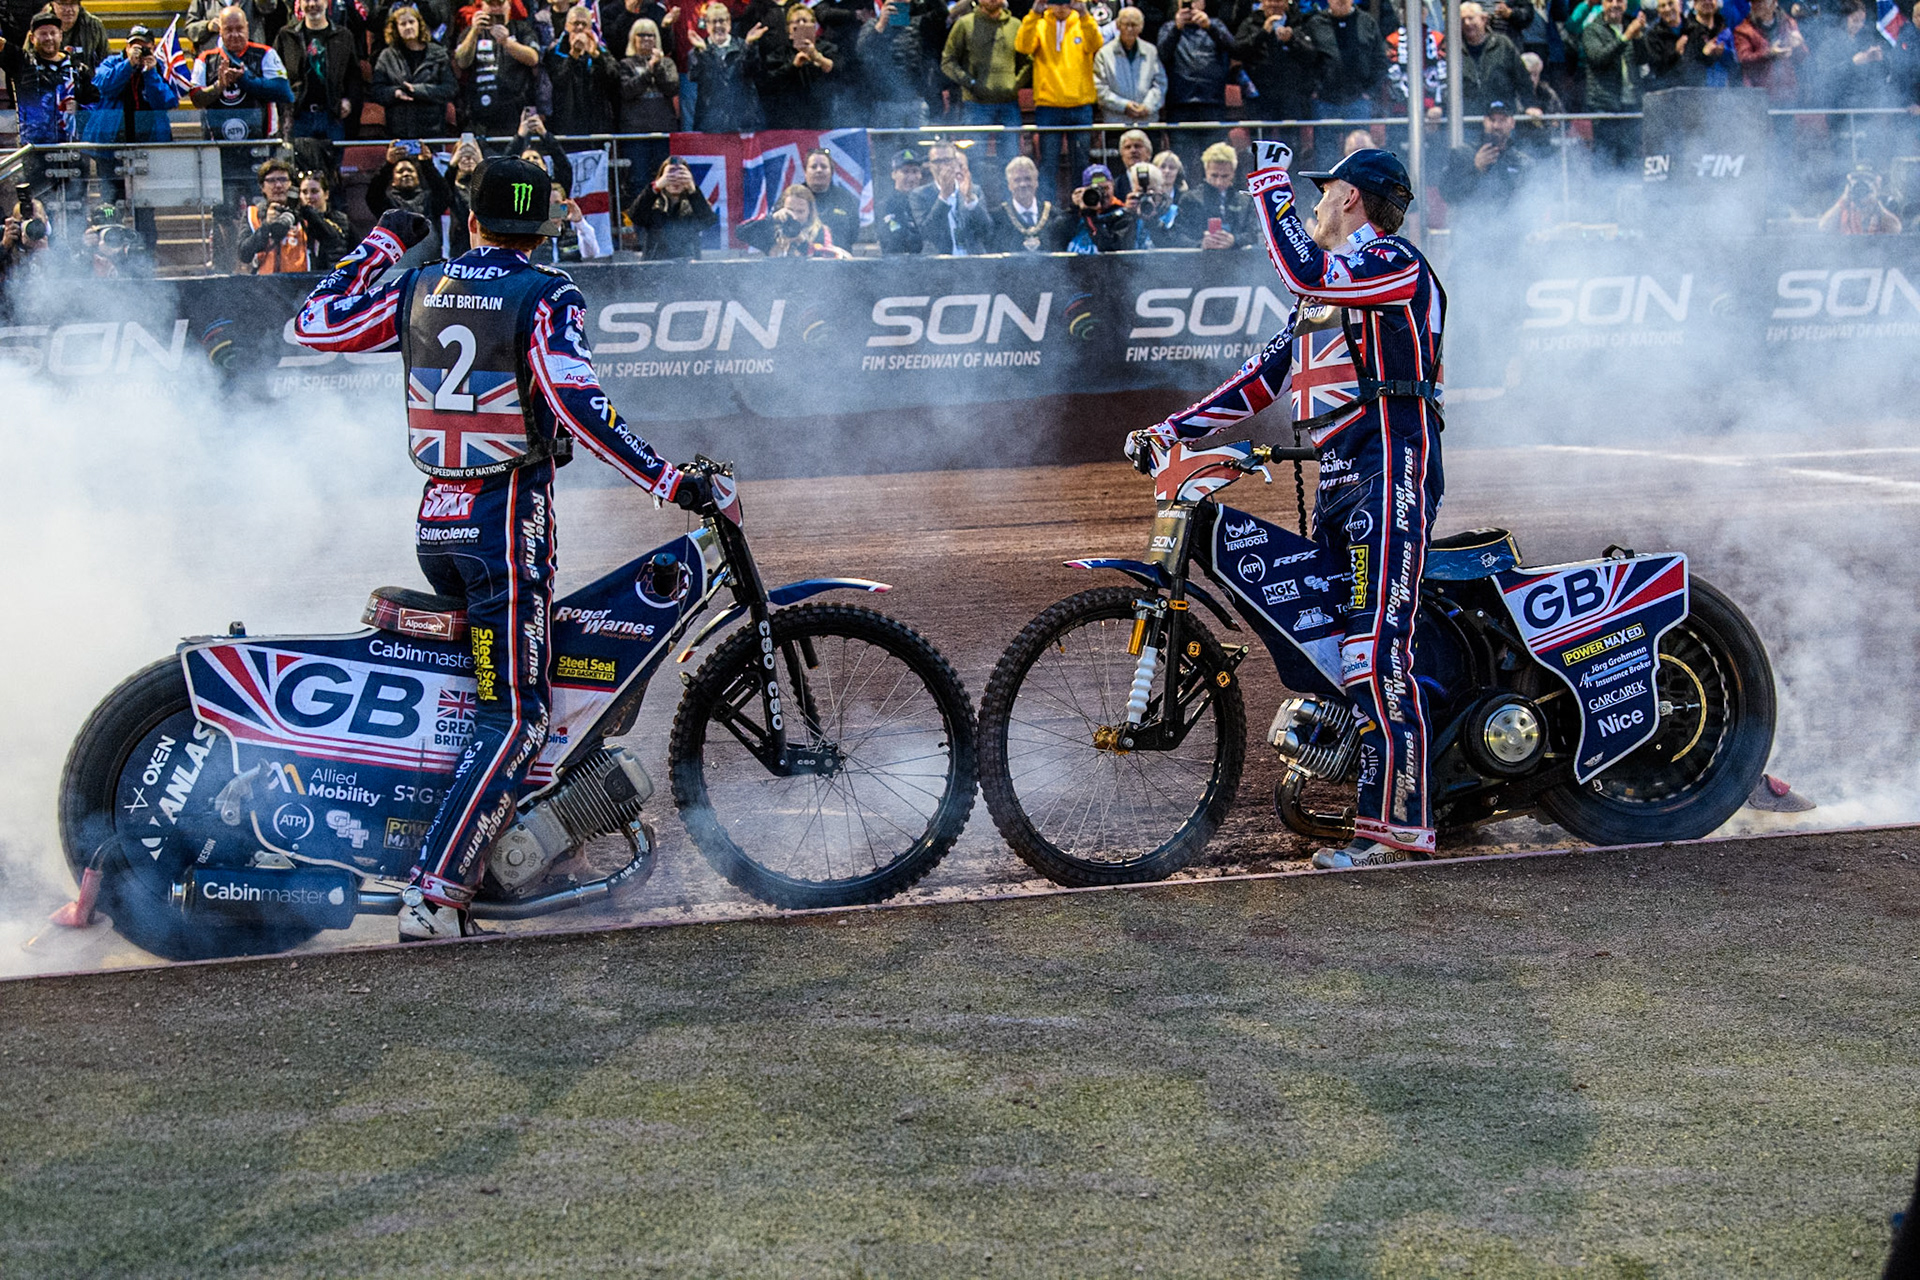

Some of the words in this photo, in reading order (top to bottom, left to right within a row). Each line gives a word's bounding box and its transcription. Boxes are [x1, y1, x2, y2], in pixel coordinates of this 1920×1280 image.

[1643, 155, 1670, 175] SON
[1695, 154, 1745, 177] FIM
[1279, 218, 1311, 263] Mobility
[423, 294, 454, 309] GREAT
[456, 296, 503, 311] BRITAIN
[1522, 273, 1694, 330] SON
[592, 300, 786, 354] SON
[866, 292, 1053, 347] SON
[862, 355, 886, 371] FIM
[888, 353, 961, 370] SPEEDWAY
[963, 352, 982, 368] OF
[984, 350, 1042, 367] NATIONS
[1126, 346, 1150, 362] FIM
[1151, 344, 1222, 361] SPEEDWAY
[1223, 343, 1241, 358] OF
[303, 373, 382, 392] SPEEDWAY
[434, 324, 477, 412] 2
[615, 361, 690, 378] SPEEDWAY
[693, 359, 713, 375] OF
[714, 358, 774, 375] NATIONS
[431, 467, 465, 477] SPEEDWAY
[465, 469, 475, 477] OF
[475, 464, 507, 476] NATIONS
[1404, 447, 1417, 507] Warnes
[531, 491, 546, 544] Roger
[1396, 484, 1410, 532] Roger
[421, 527, 480, 541] Silkolene
[1152, 536, 1177, 548] SON
[1243, 561, 1262, 575] ATPI
[1273, 549, 1320, 568] RFX
[1399, 541, 1412, 603] Warnes
[1264, 581, 1297, 600] NGK
[1355, 549, 1366, 606] POWER
[1386, 578, 1401, 628] Roger
[1523, 569, 1605, 629] GB
[532, 593, 546, 645] Roger
[556, 606, 612, 624] Roger
[582, 619, 655, 636] Warnes
[369, 640, 473, 669] Cabinmaste
[479, 628, 494, 669] Steel
[523, 622, 538, 686] Warnes
[1565, 642, 1605, 663] POWER
[1603, 626, 1643, 649] MAXED
[1591, 662, 1608, 673] Jörg
[1608, 646, 1647, 666] Grohmann
[559, 656, 589, 669] Steel
[590, 659, 615, 673] Seal
[1389, 637, 1407, 696] Warnes
[1595, 669, 1629, 688] Insurance
[1629, 660, 1652, 674] Broker
[482, 669, 498, 701] Seal
[1383, 676, 1406, 724] Roger
[1588, 680, 1647, 710] GARCAREK
[275, 662, 425, 739] GB
[435, 720, 476, 735] GREA
[1597, 709, 1644, 738] Nice
[142, 734, 176, 785] OXEN
[506, 723, 537, 779] Warnes
[1404, 731, 1417, 794] Warnes
[159, 720, 217, 825] ANLAS
[311, 768, 357, 785] Allied
[309, 783, 381, 807] Mobility
[279, 814, 307, 827] ATPI
[488, 793, 511, 842] Roger
[198, 838, 217, 864] DESIGN
[457, 812, 491, 876] Warnes
[203, 881, 326, 904] Cabinmaster
